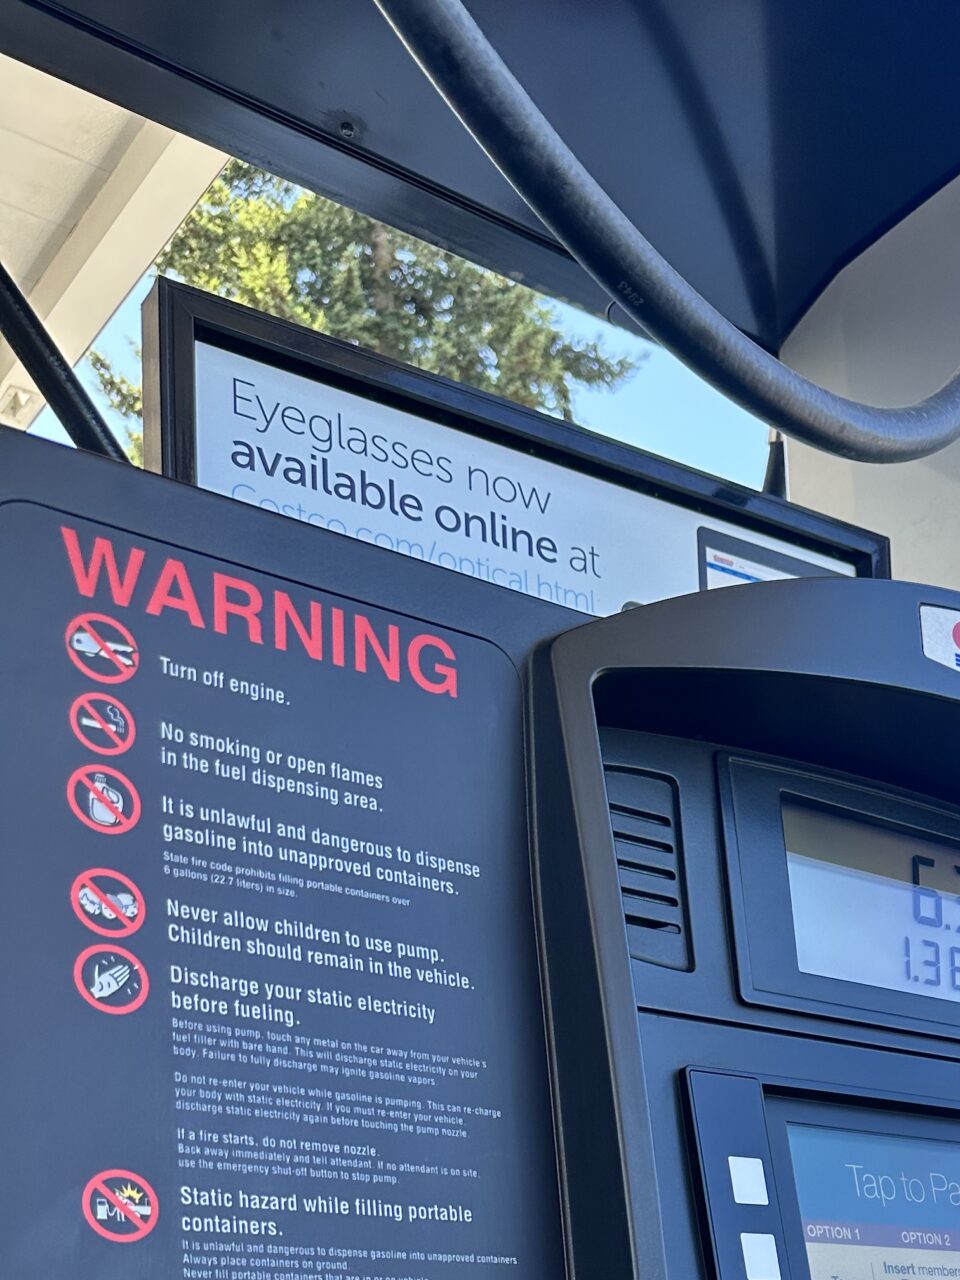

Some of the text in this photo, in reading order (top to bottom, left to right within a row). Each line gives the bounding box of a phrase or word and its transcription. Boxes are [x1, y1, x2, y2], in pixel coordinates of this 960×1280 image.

[232, 378, 551, 514] Eyeglasses now
[231, 438, 601, 578] available online at
[61, 526, 458, 698] WARNING
[159, 656, 290, 705] Turn off engine.
[161, 721, 382, 789] No smoking or open flames
[161, 746, 382, 812] in the fuel dispensing area.
[166, 898, 444, 964] Never allow children to use pump.
[170, 965, 435, 1024] Discharge your static electricity
[171, 990, 300, 1027] before fueling.
[180, 1185, 472, 1222] Static hazard while filling portable
[844, 1163, 896, 1207] Tap
[900, 1172, 925, 1203] to
[182, 1215, 282, 1235] containers.
[806, 1224, 860, 1240] OPTION 1
[901, 1231, 951, 1246] OPTION 2
[883, 1261, 916, 1275] Insert
